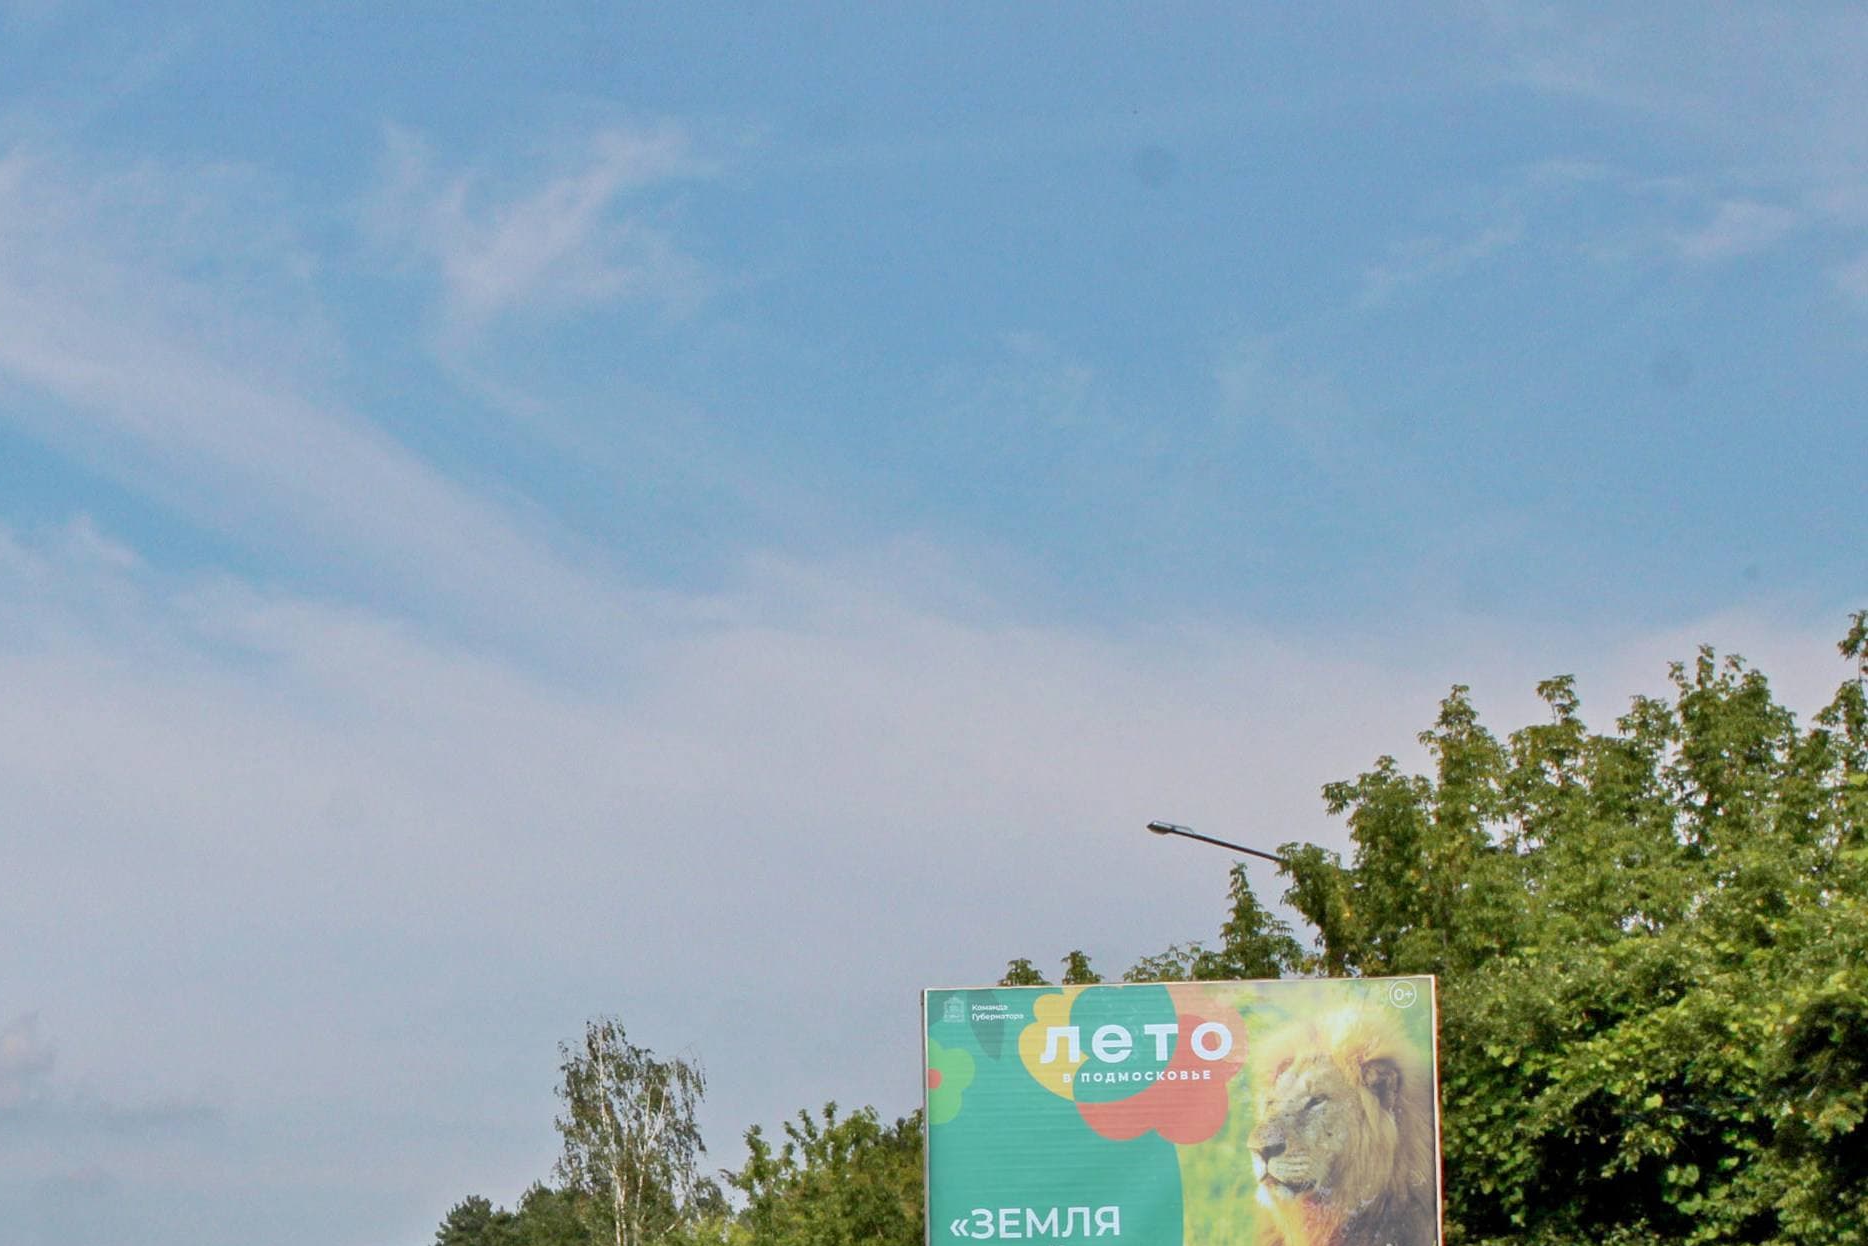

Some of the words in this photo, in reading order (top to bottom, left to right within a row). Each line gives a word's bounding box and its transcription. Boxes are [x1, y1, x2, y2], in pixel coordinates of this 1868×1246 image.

[1394, 988, 1413, 1001] 0+
[971, 1003, 1009, 1012] Команда
[971, 1013, 1025, 1022] Губернатора
[949, 1206, 1121, 1240] «ЗЕМЛЯ
